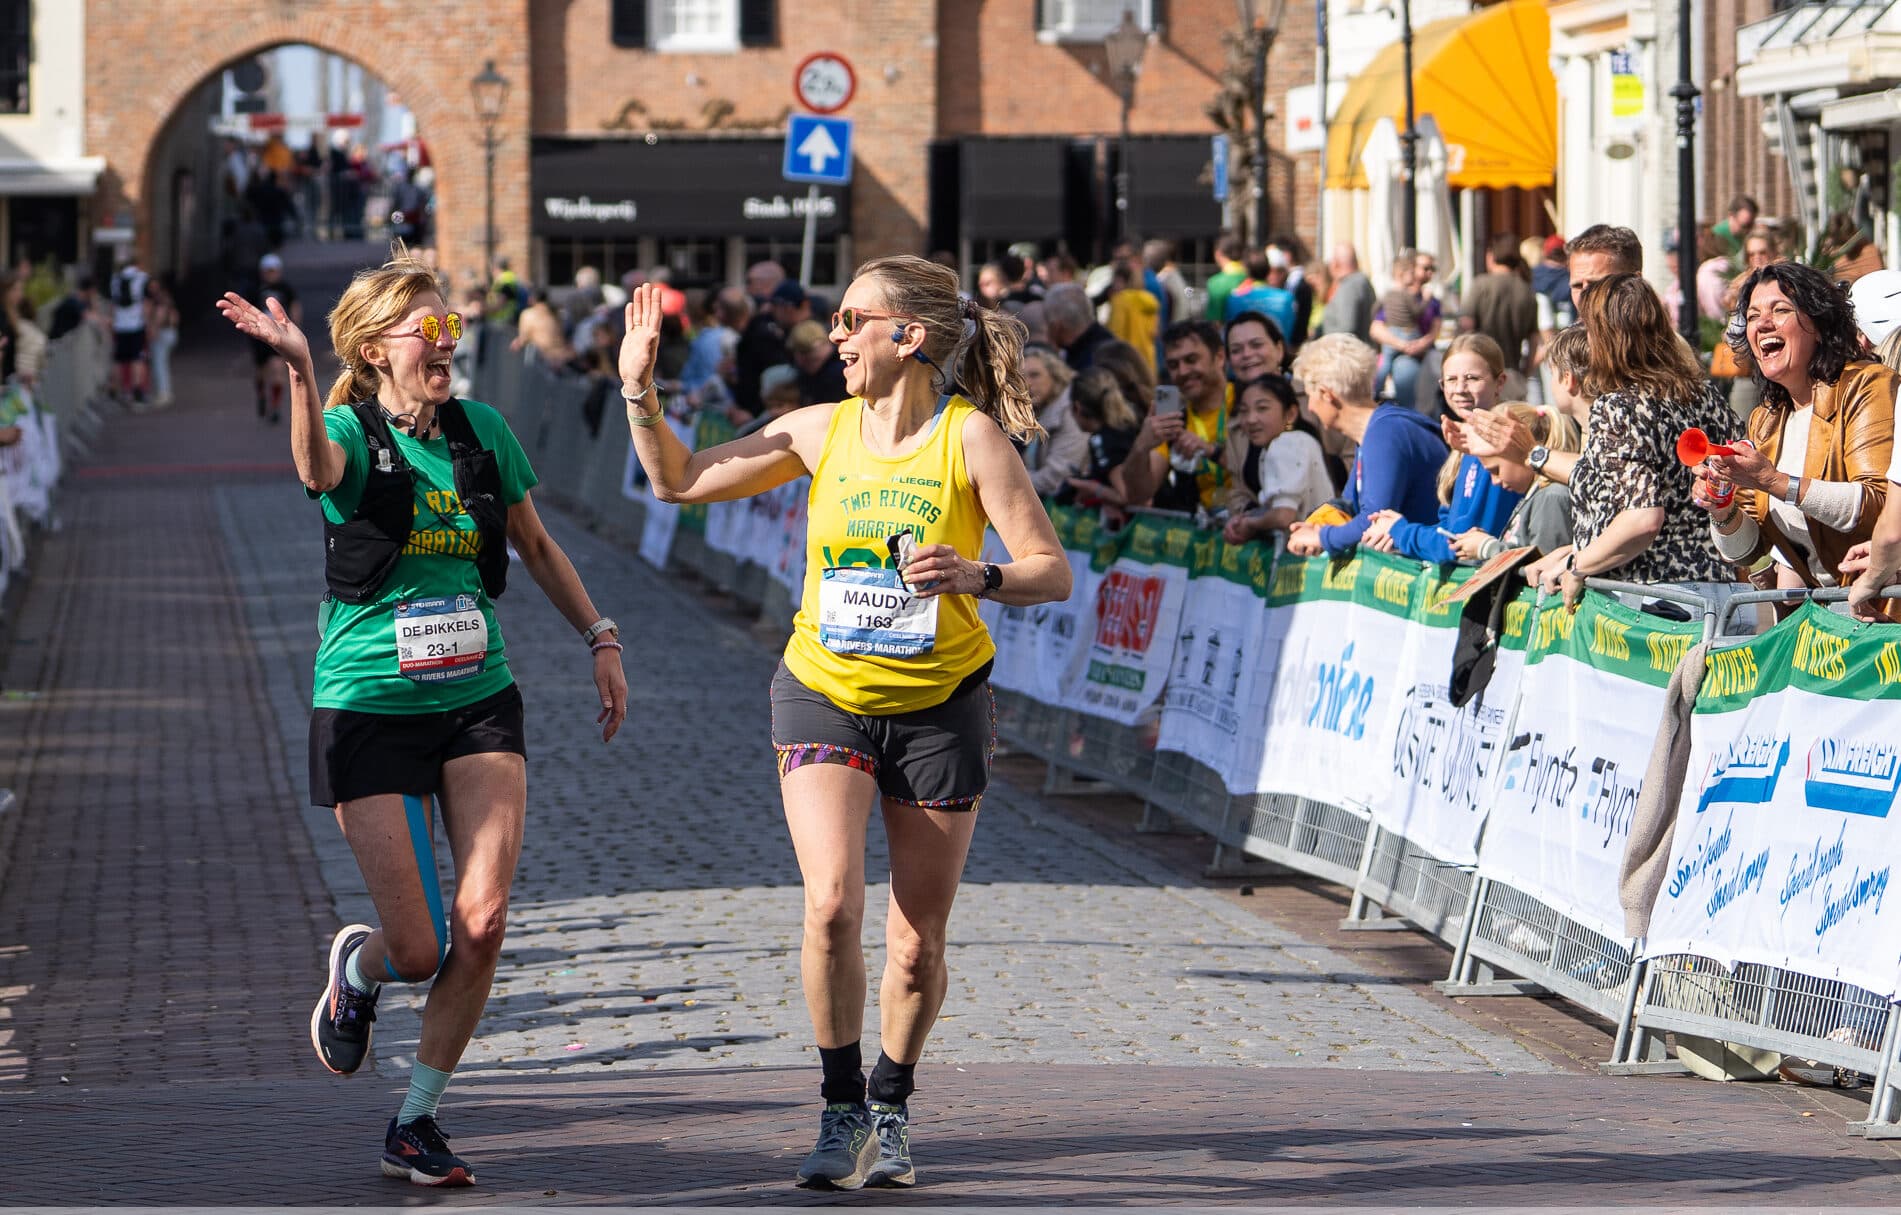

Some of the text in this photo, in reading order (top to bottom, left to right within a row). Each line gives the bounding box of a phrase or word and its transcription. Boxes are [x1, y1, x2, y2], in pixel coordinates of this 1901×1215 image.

[840, 489, 942, 524] TWO RIVERS
[843, 590, 911, 611] MAUDY
[402, 619, 480, 638] DE BIKKELS
[856, 614, 892, 628] 1163
[426, 642, 459, 657] 23-1
[421, 671, 445, 681] RIVERS
[446, 665, 480, 678] MARATHON
[1713, 646, 1759, 697] RIVERS
[1522, 732, 1579, 815] Flynth
[1593, 760, 1644, 849] Flyn
